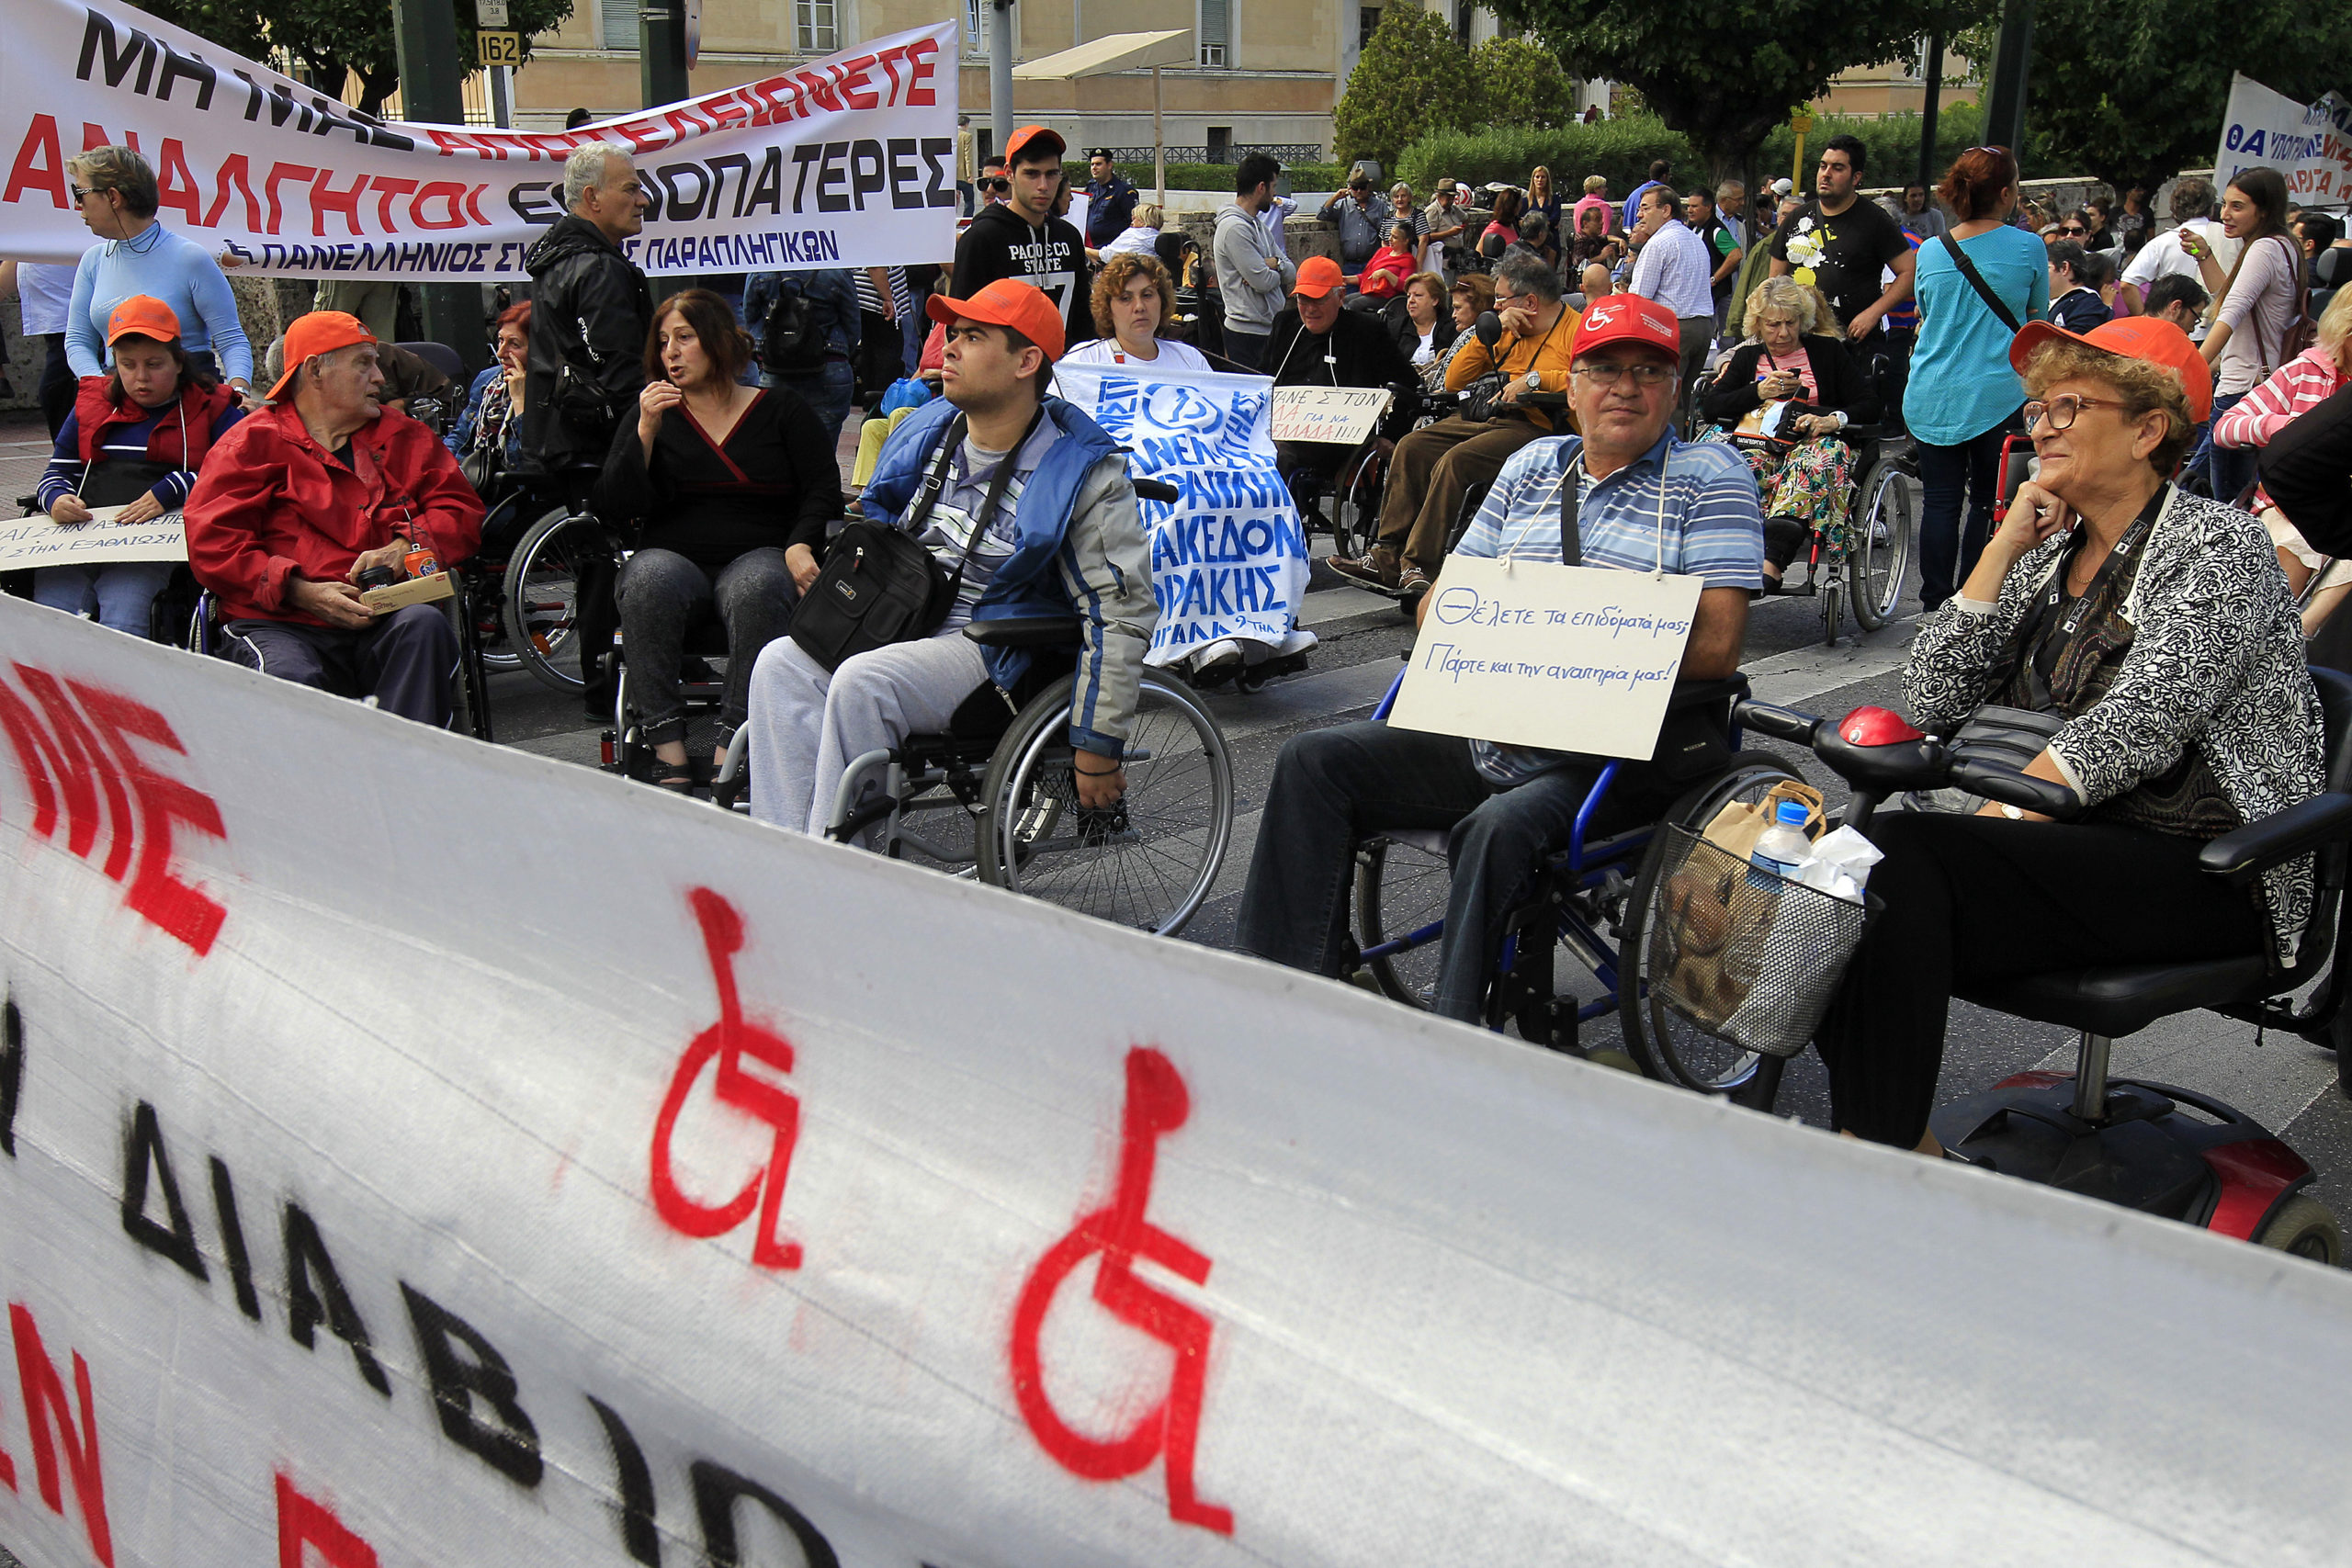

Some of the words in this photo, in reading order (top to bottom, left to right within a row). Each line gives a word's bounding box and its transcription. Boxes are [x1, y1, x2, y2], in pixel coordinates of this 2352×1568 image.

[76, 7, 217, 111] ΜΗ
[481, 36, 516, 61] 162
[2225, 123, 2267, 157] ΘΑ
[261, 242, 492, 273] ΠΑΝΕΛΛΗΝΙΟΣ
[645, 230, 840, 269] ΠΑΡΑΠΛΗΓΙΚΩΝ
[1023, 257, 1062, 273] STATE
[5, 543, 64, 558] ΣΤΗΝ
[69, 533, 181, 550] ΕΞΑΘΛΙΩΣΗ
[1436, 587, 1535, 626] Θέλετε
[1425, 643, 1486, 683] Πάρτε
[1489, 661, 1513, 673] και
[1546, 664, 1629, 687] αναπηρία
[1627, 660, 1678, 691] μας!
